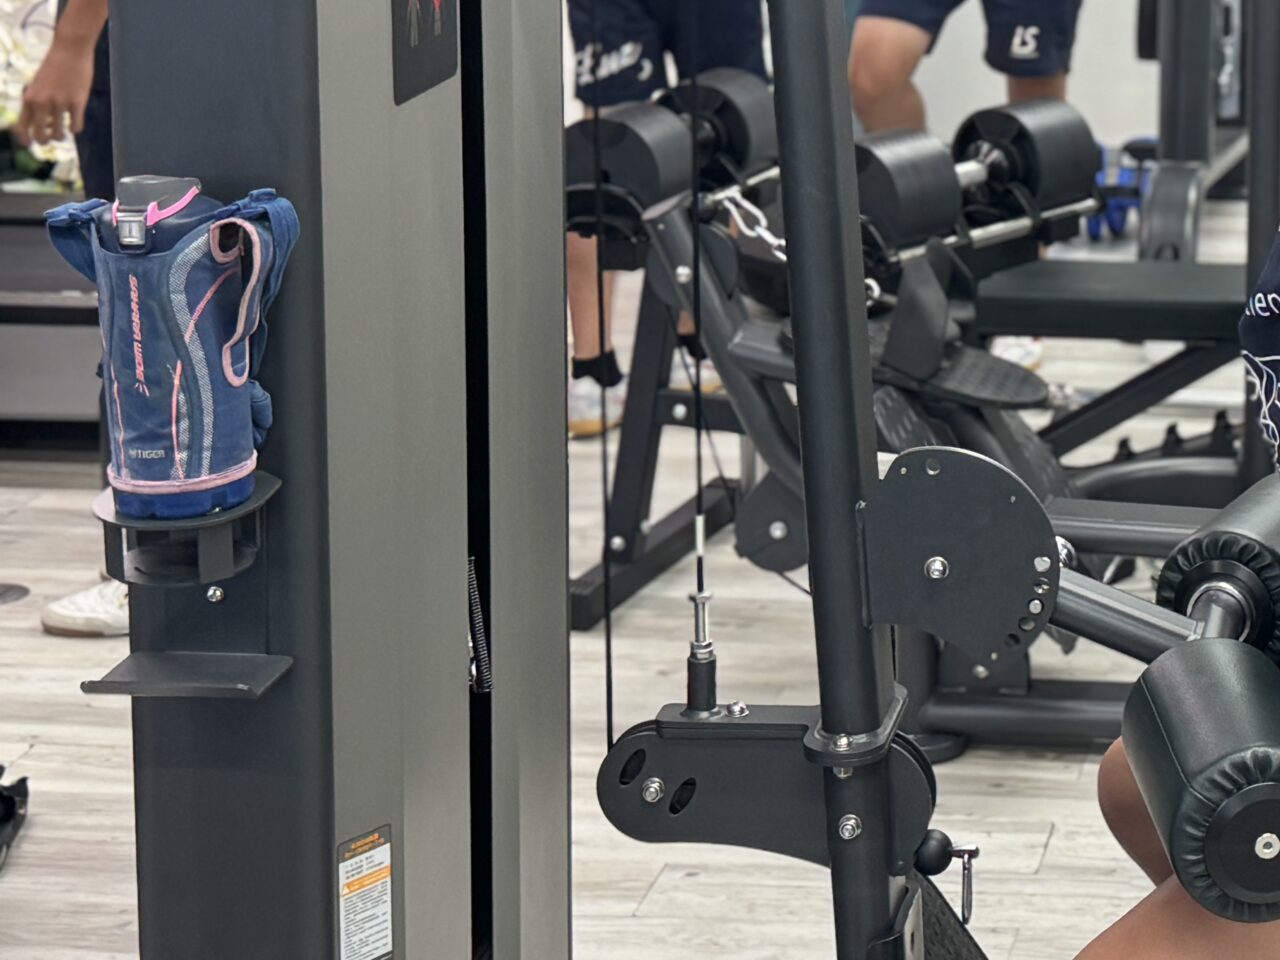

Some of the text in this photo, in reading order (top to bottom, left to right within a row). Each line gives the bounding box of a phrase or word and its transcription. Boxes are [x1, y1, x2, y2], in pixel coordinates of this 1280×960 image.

[129, 273, 145, 382] SAHARA WIDE
[138, 449, 166, 459] TIGER
